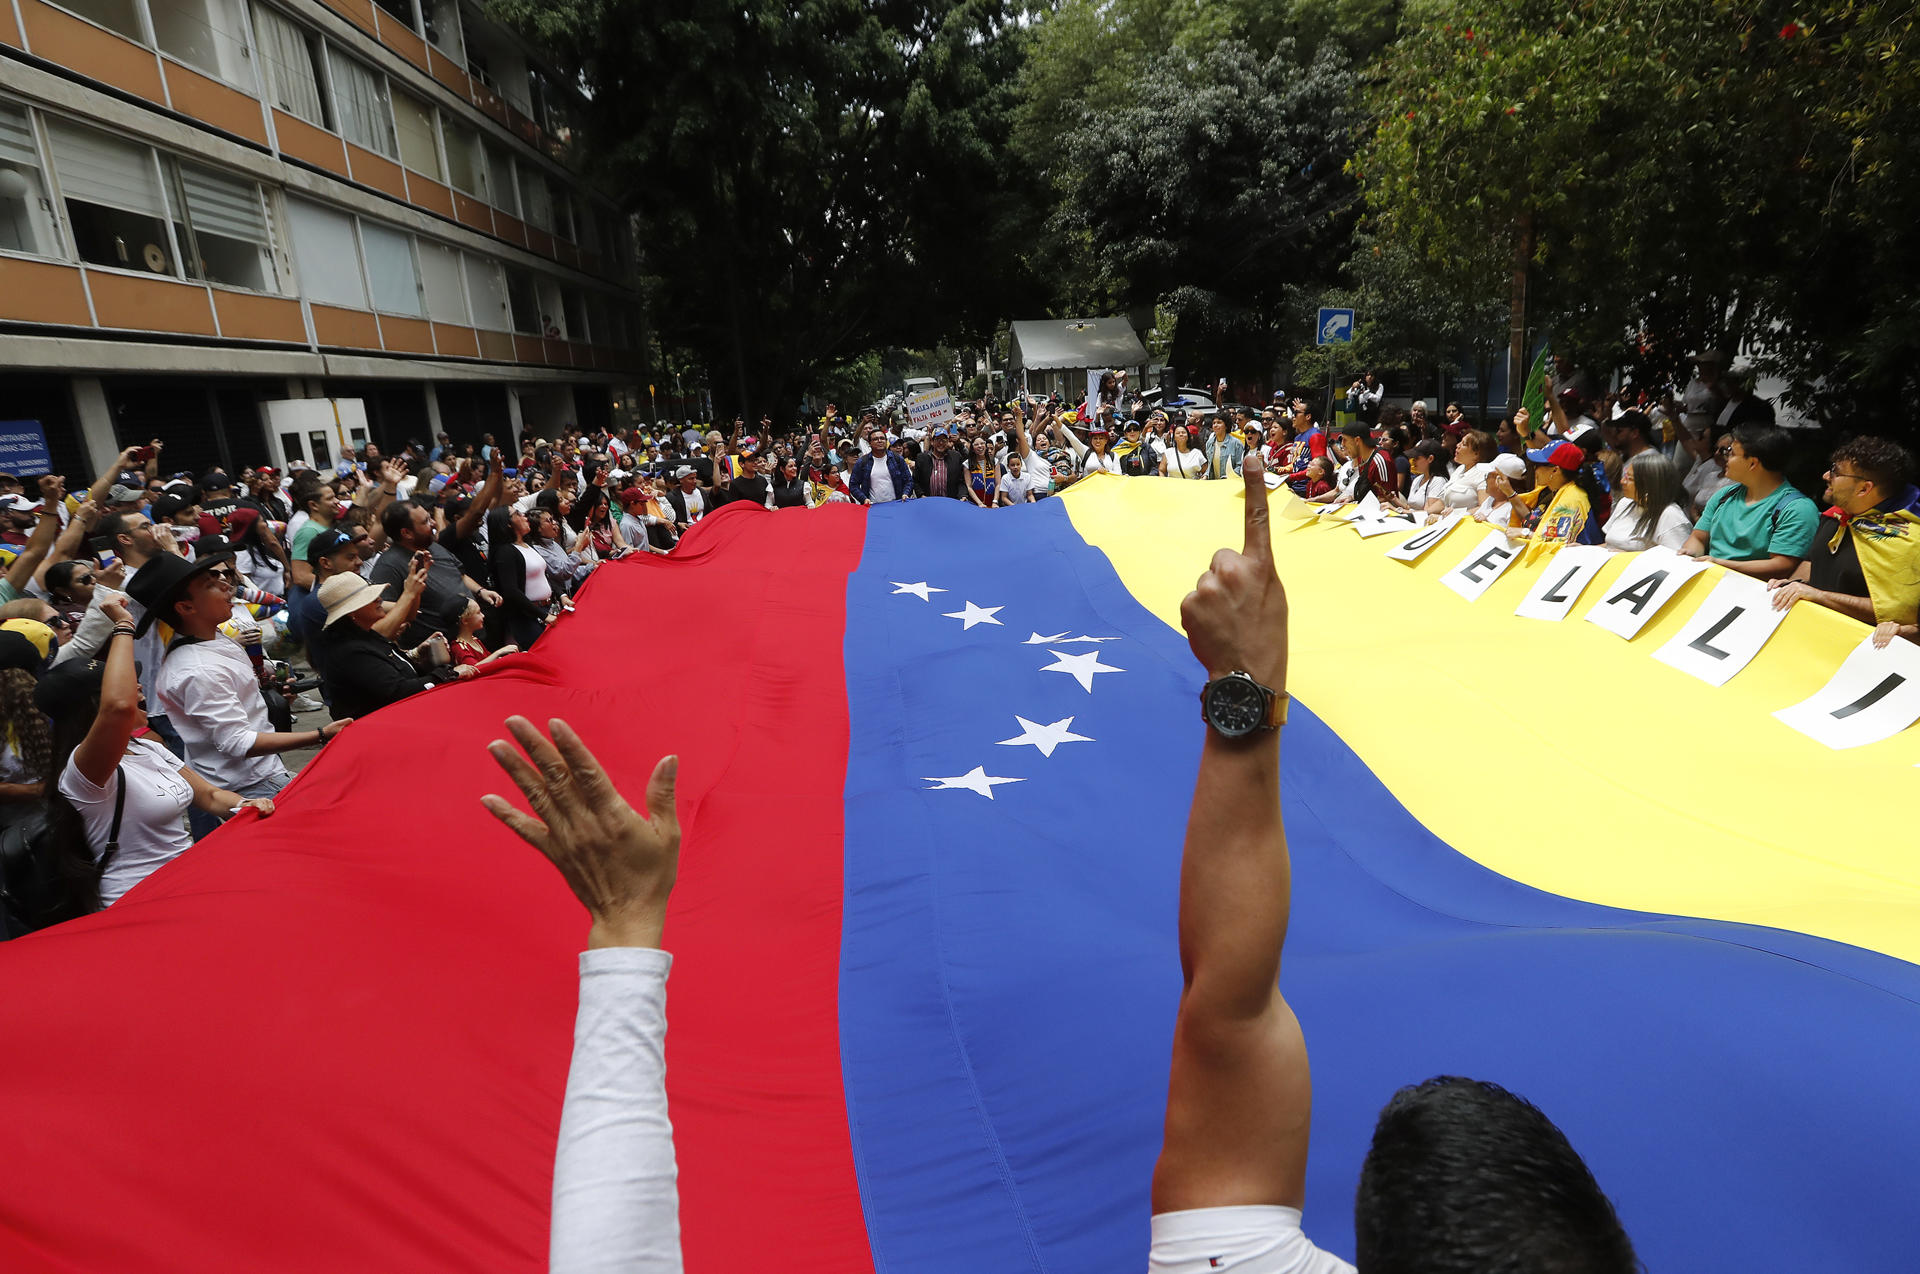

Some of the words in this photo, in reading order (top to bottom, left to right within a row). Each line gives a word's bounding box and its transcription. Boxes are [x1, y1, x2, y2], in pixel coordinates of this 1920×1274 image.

[910, 404, 929, 414] HUELES
[1346, 400, 1352, 408] P
[913, 415, 928, 423] FALTA
[930, 410, 942, 418] POCO
[1460, 547, 1512, 583] E
[1541, 565, 1581, 603] L
[1607, 571, 1668, 615] A
[1688, 606, 1745, 660] L
